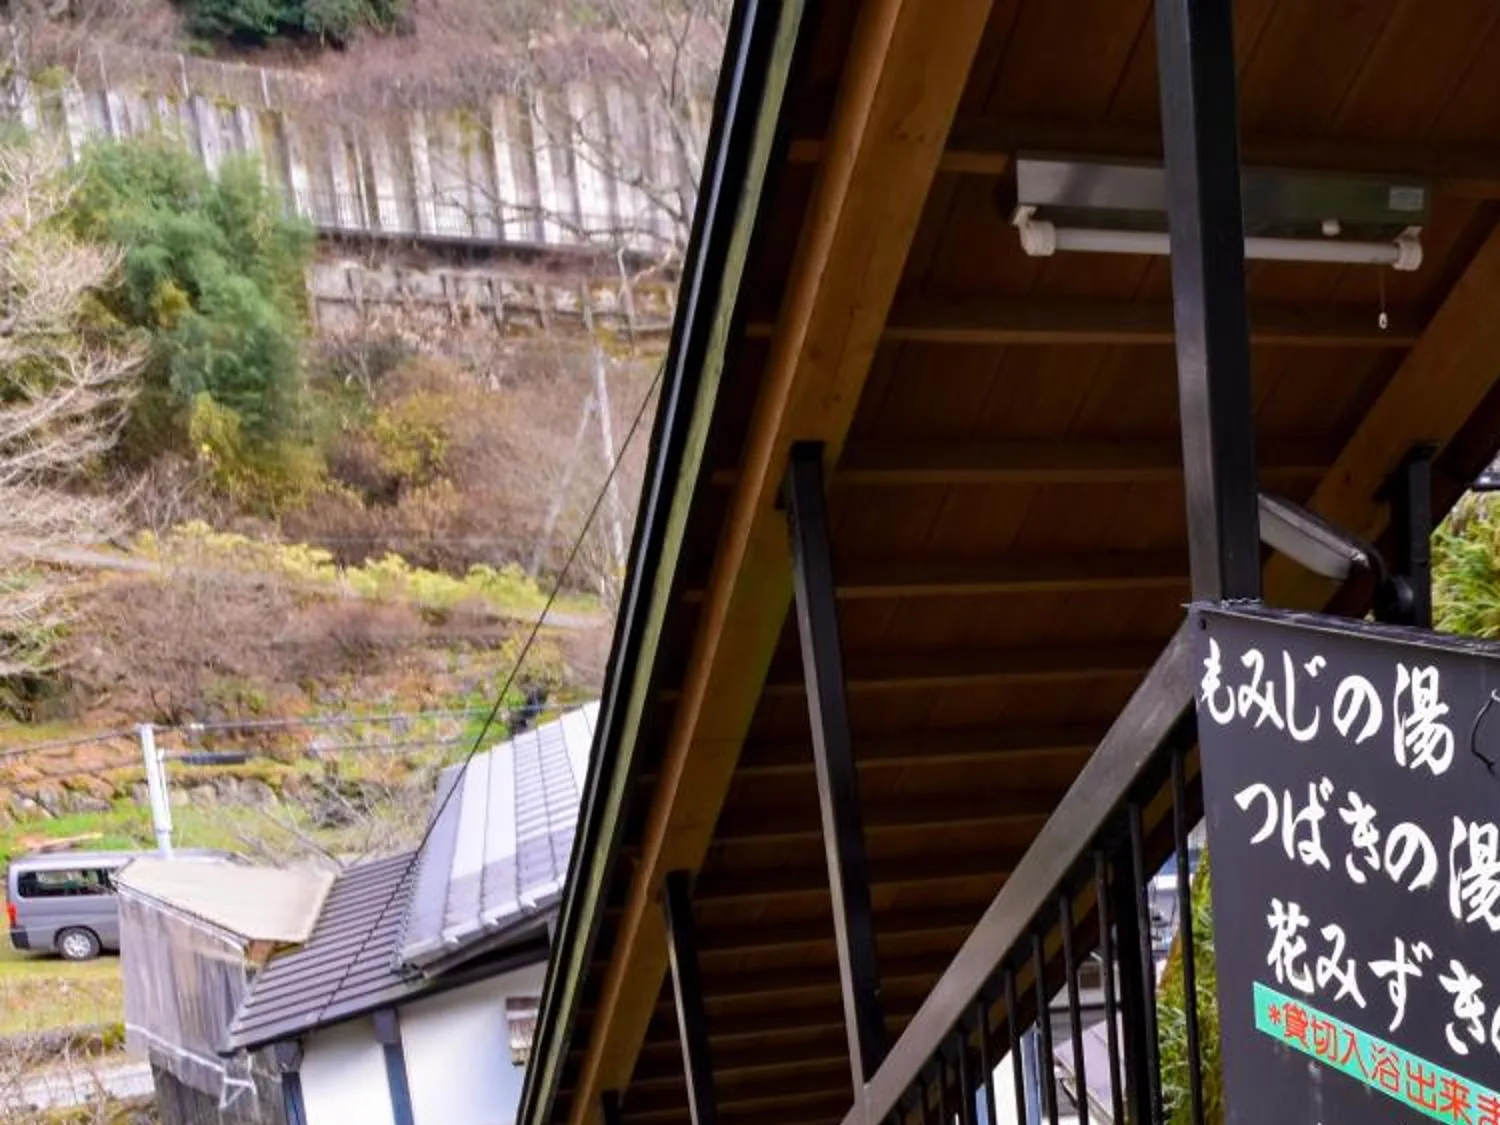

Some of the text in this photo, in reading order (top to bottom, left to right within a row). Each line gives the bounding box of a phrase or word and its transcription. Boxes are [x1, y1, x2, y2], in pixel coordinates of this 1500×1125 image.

[1201, 637, 1455, 775] もみじの湯
